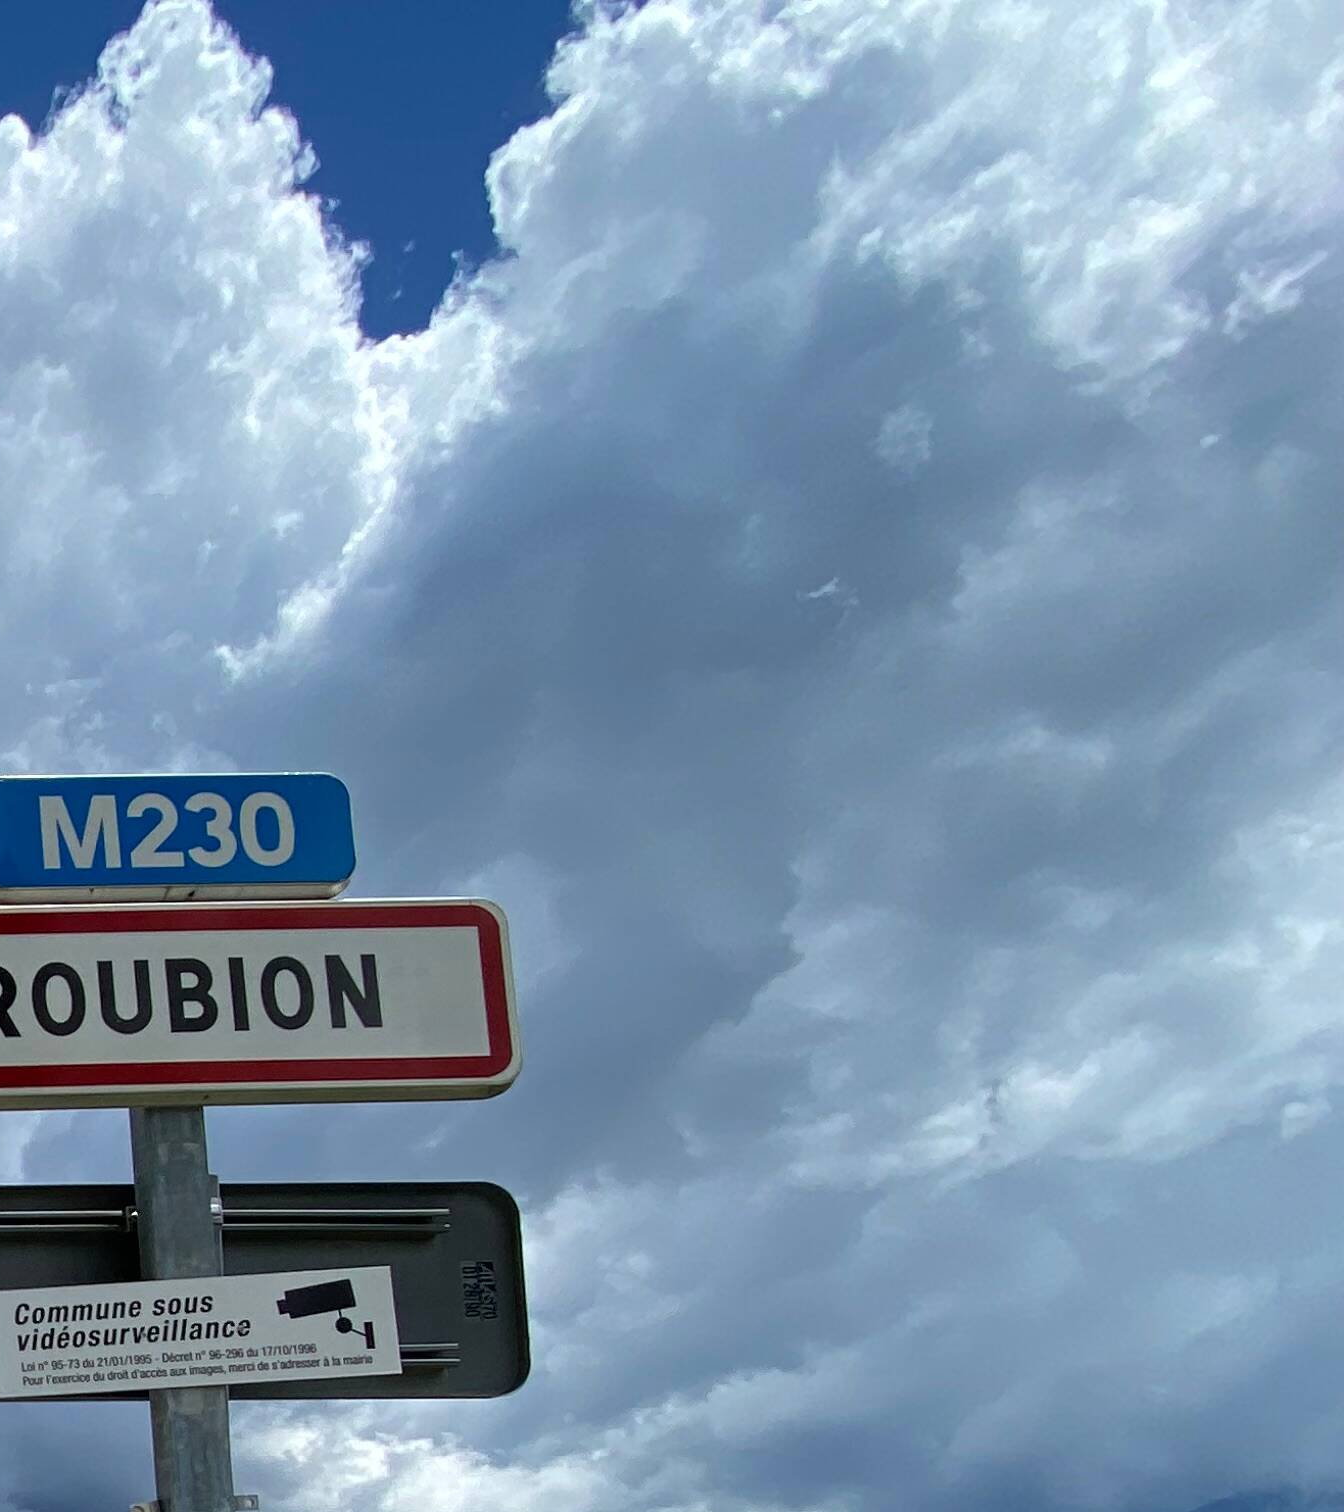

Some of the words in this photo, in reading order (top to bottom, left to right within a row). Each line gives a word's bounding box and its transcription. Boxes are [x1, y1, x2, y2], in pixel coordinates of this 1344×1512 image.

[38, 791, 296, 870] M230
[15, 1299, 142, 1326] Commune
[152, 1294, 214, 1317] sous
[17, 1318, 252, 1351] vidéosurveillance
[21, 1361, 36, 1373] Loi
[51, 1358, 81, 1371] 95-73
[82, 1356, 96, 1369] du
[97, 1354, 153, 1369] 21/01/1995
[162, 1351, 194, 1363] Décret
[209, 1347, 244, 1361] 96-296
[246, 1346, 259, 1358] du
[262, 1343, 317, 1357] 17/10/1996
[23, 1375, 43, 1387] Pour
[46, 1371, 90, 1385] l'exercice
[93, 1370, 105, 1382] du
[107, 1368, 129, 1381] droit
[170, 1366, 187, 1377] aux
[189, 1363, 226, 1377] images,
[228, 1361, 256, 1373] merci
[257, 1360, 269, 1372] de
[272, 1357, 321, 1371] s'adresser
[323, 1355, 330, 1366] à
[332, 1355, 341, 1366] la
[342, 1353, 373, 1366] mairie
